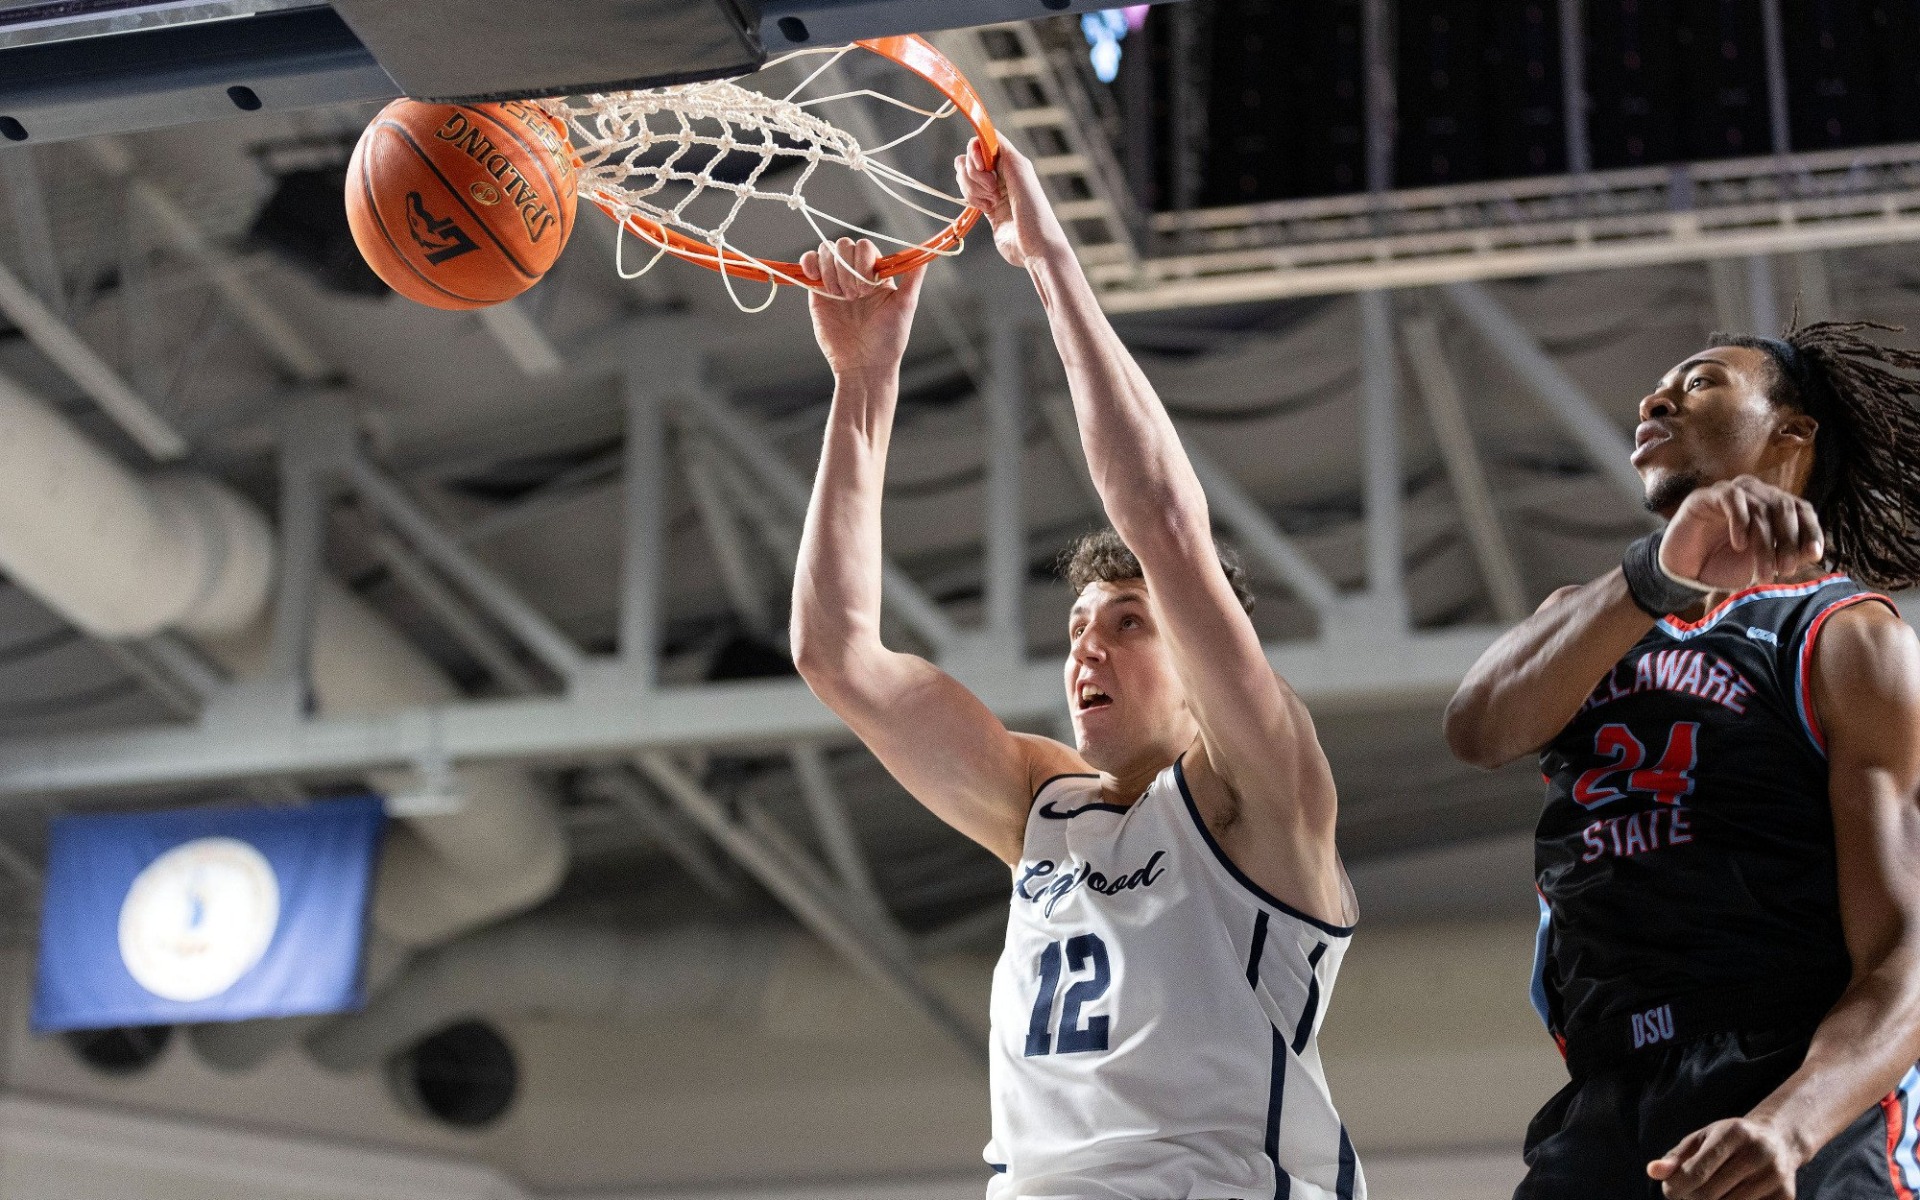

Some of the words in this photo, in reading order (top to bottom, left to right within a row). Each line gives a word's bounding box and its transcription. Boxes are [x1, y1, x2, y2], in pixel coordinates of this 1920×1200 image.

[434, 111, 556, 243] SPALDING
[1583, 649, 1757, 715] LAWARE
[1572, 721, 1701, 811] 24
[1582, 807, 1695, 864] STATE
[1024, 932, 1111, 1057] 12
[1631, 1003, 1676, 1049] DSU
